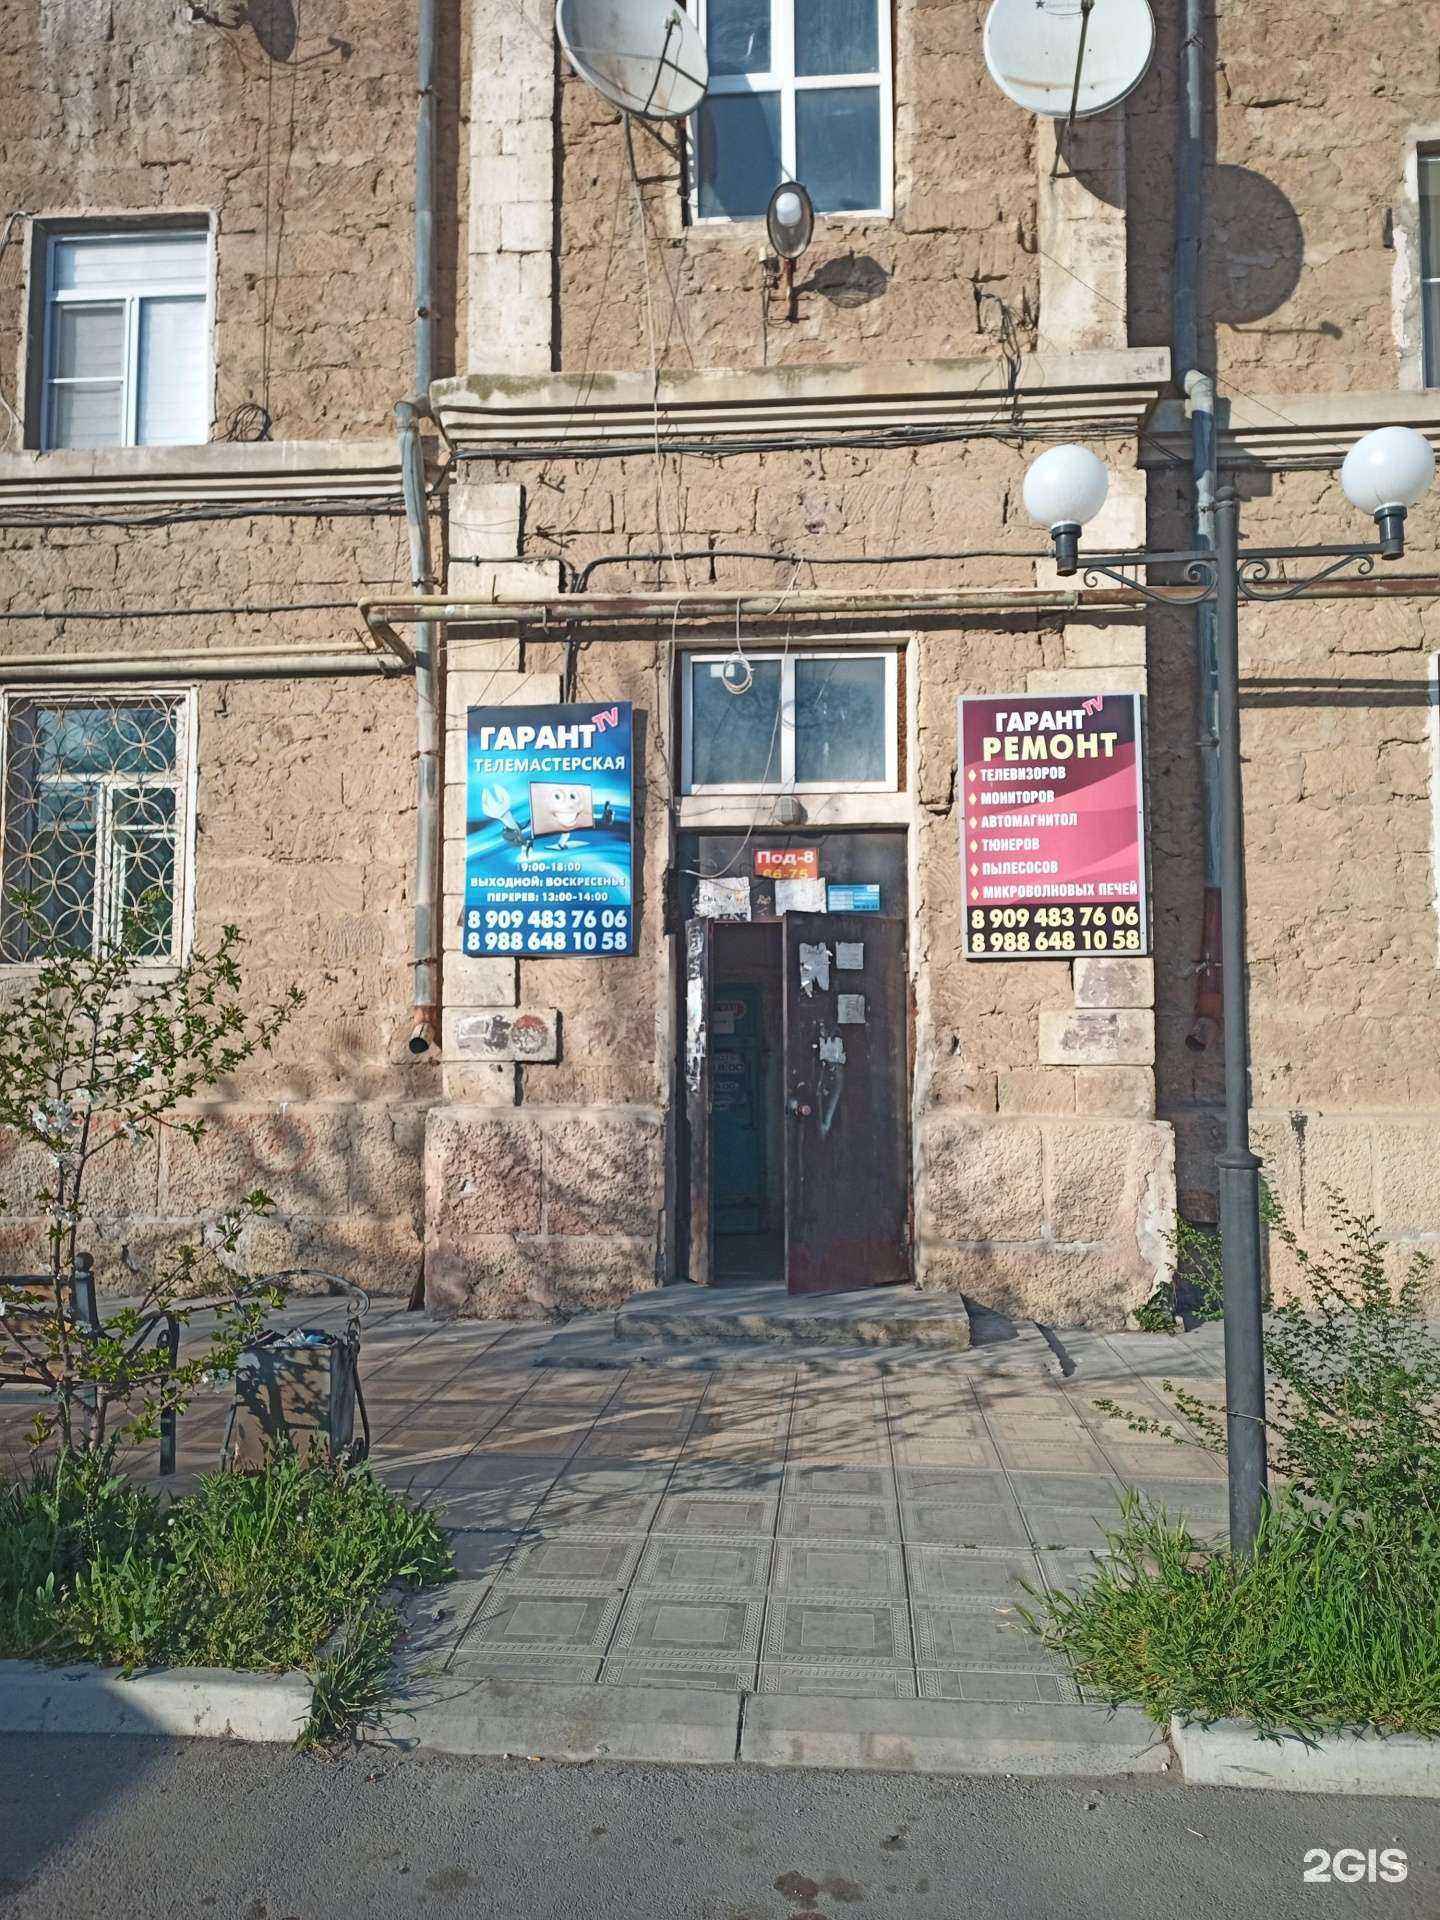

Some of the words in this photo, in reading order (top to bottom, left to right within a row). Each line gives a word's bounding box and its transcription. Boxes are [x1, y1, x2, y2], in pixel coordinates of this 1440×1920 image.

[1082, 696, 1104, 716] TV
[592, 707, 619, 732] TV
[994, 709, 1086, 733] ГАРАНТ
[480, 724, 596, 751] ГАРАНТ
[982, 732, 1118, 762] РЕМОНТ
[474, 756, 625, 773] ТЕЛЕМАСТЕРСКАЯ
[980, 766, 1066, 782] ТЕЛЕВИЗОРОВ
[980, 790, 1055, 805] МОНИТОРОВ
[981, 812, 1078, 828] АВТОМАГНИТОЛ
[982, 838, 1040, 852] ТЮНЕРОВ
[757, 850, 815, 865] Под-8
[982, 861, 1059, 876] ПЫЛЕСОСОВ
[470, 875, 543, 888] ВЫХОДНОЙ:
[545, 876, 626, 888] ВОСКРЕСЕНЬЕ
[982, 882, 1095, 899] МИКРОВОЛНОВЫХ
[1098, 880, 1138, 897] ПЕЧЕЙ
[542, 892, 608, 902] 13:00-14:00
[467, 910, 481, 929] 8
[485, 910, 524, 929] 909
[528, 910, 566, 929] 483
[571, 910, 597, 929] 76
[601, 910, 628, 929] 06
[972, 909, 986, 930] 8
[990, 908, 1030, 929] 909
[1034, 907, 1075, 928] 483
[1079, 906, 1107, 926] 76
[1111, 906, 1139, 926] 06
[467, 932, 481, 950] 8
[485, 932, 524, 950] 988
[528, 932, 566, 950] 648
[573, 931, 597, 950] 10
[602, 931, 628, 950] 58
[972, 932, 986, 952] 8
[990, 932, 1031, 952] 988
[1035, 931, 1076, 951] 648
[1082, 930, 1107, 950] 10
[1112, 929, 1140, 950] 58
